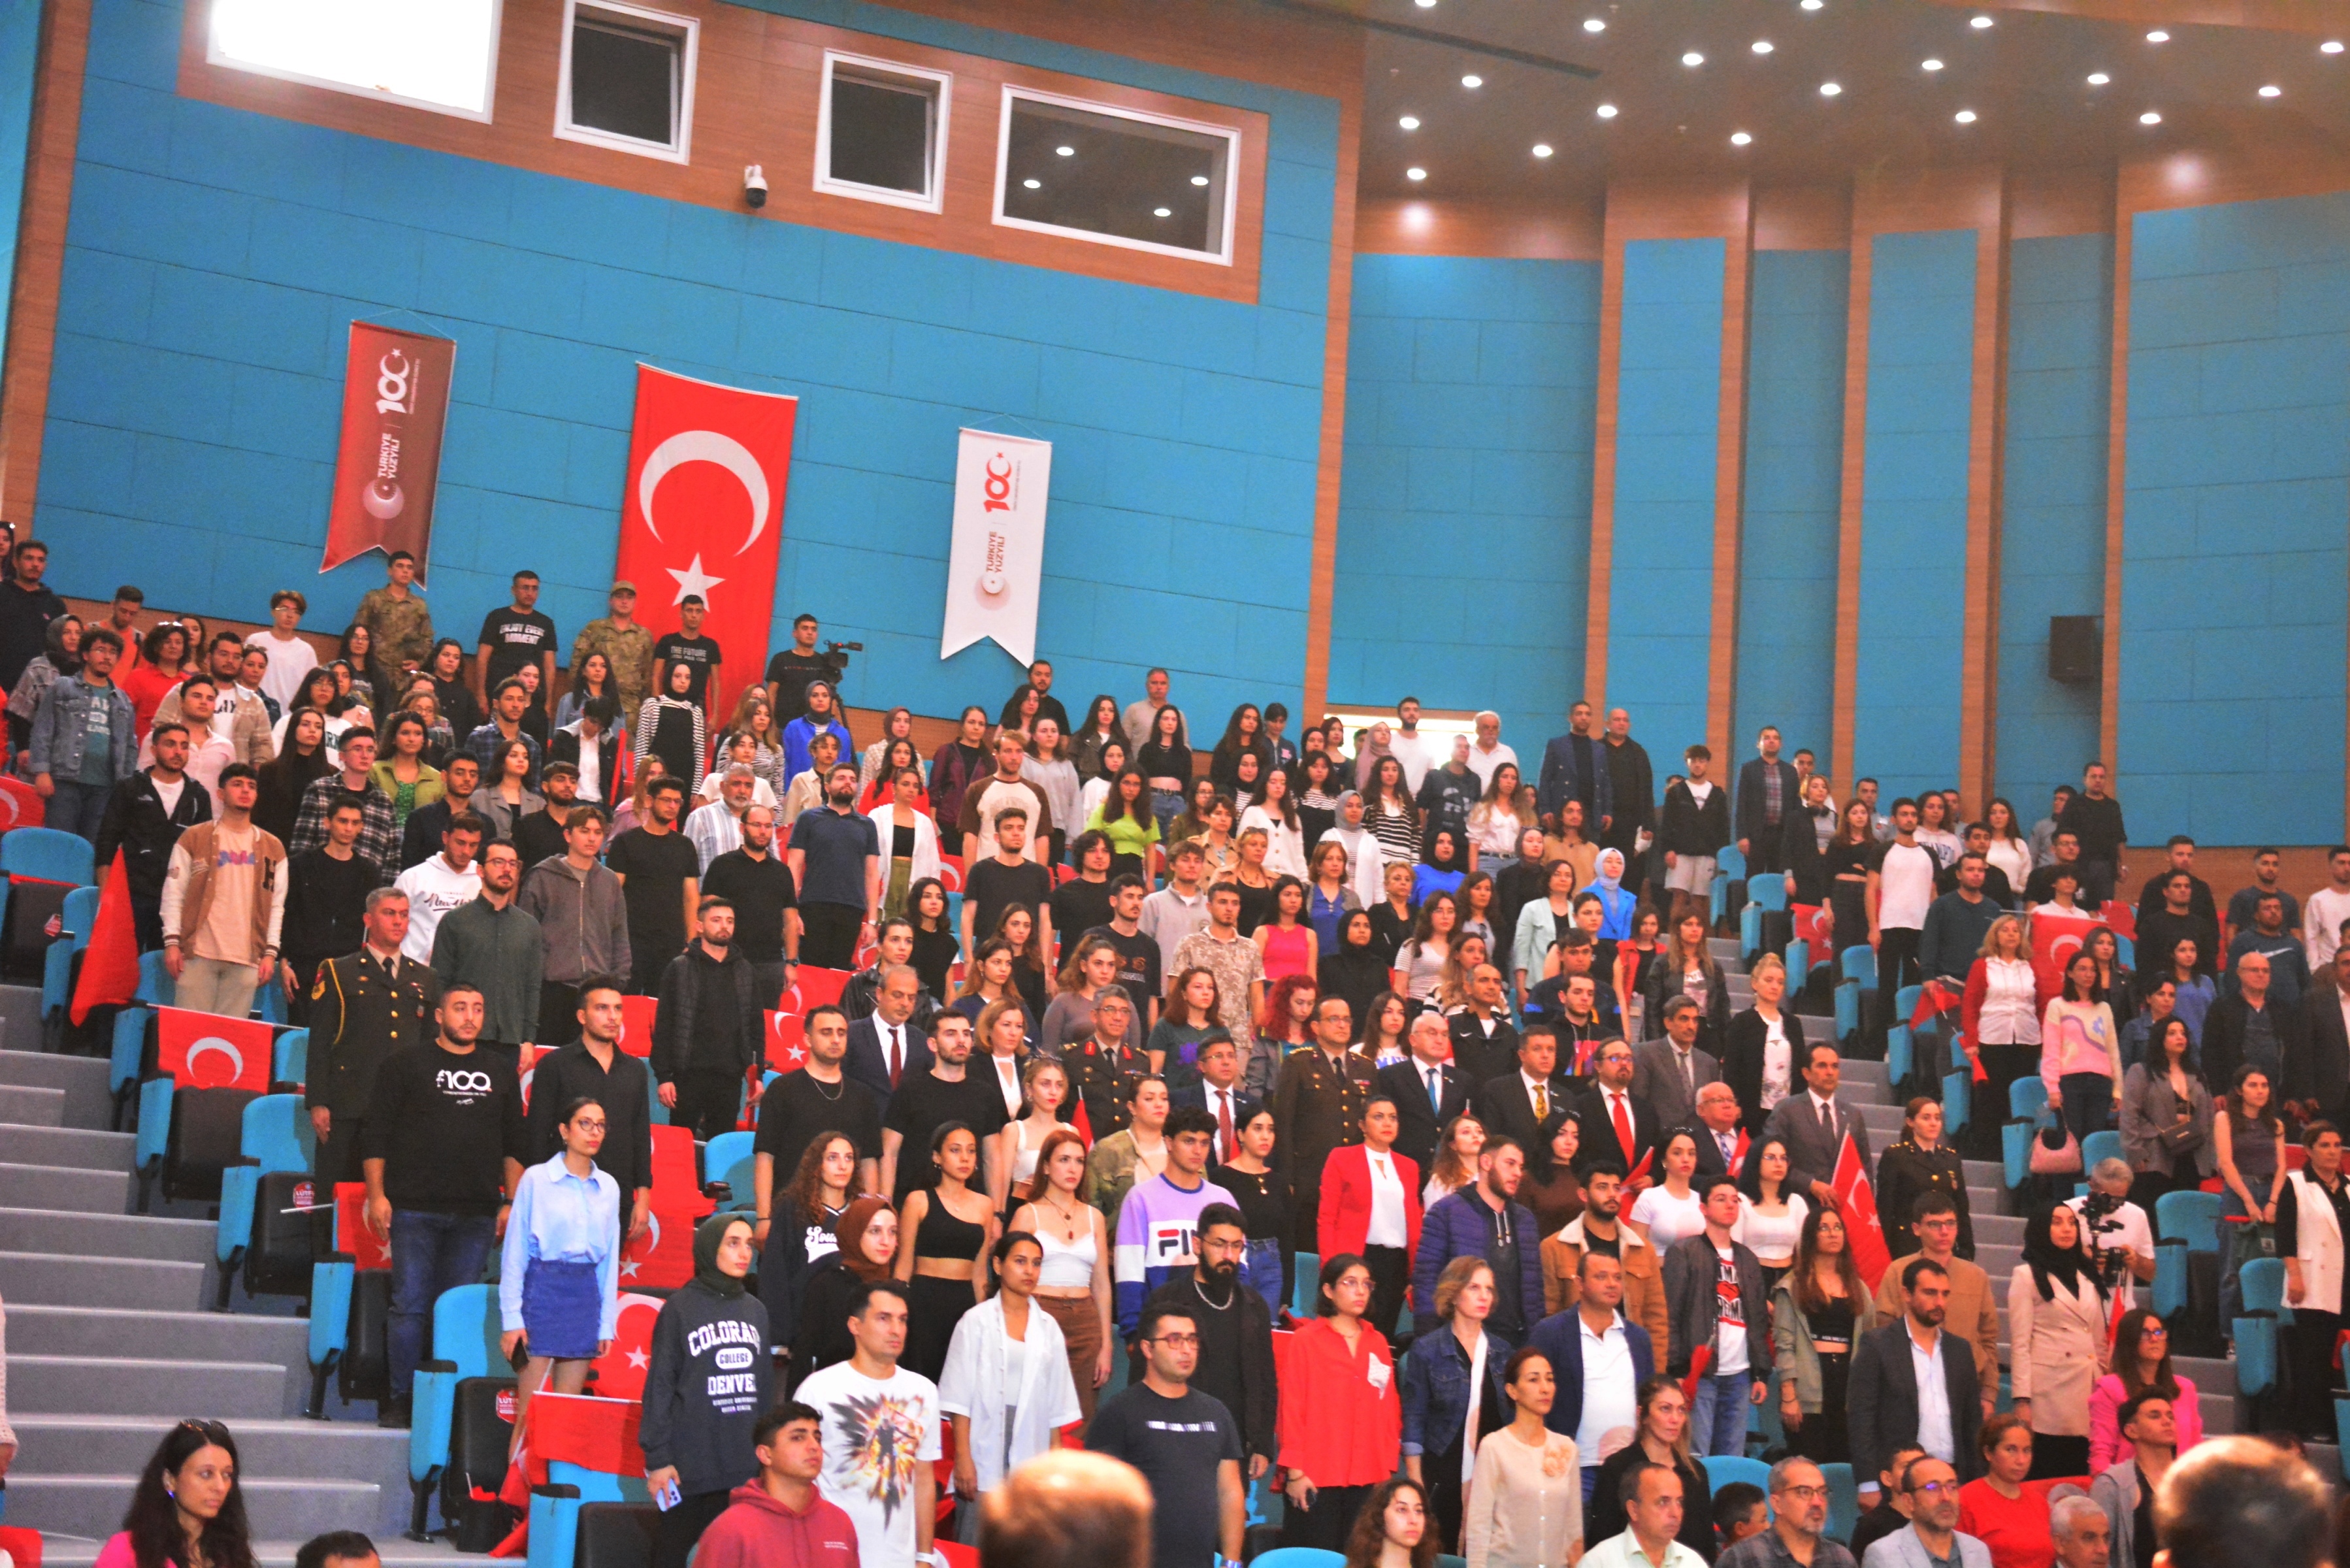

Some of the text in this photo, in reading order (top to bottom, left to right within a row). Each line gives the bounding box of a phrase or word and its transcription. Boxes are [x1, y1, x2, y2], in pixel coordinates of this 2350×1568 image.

[1158, 1229, 1197, 1257] FI
[688, 1320, 760, 1357] COLORAD
[719, 1353, 749, 1364] COLLEGE
[708, 1373, 757, 1396] DENVE
